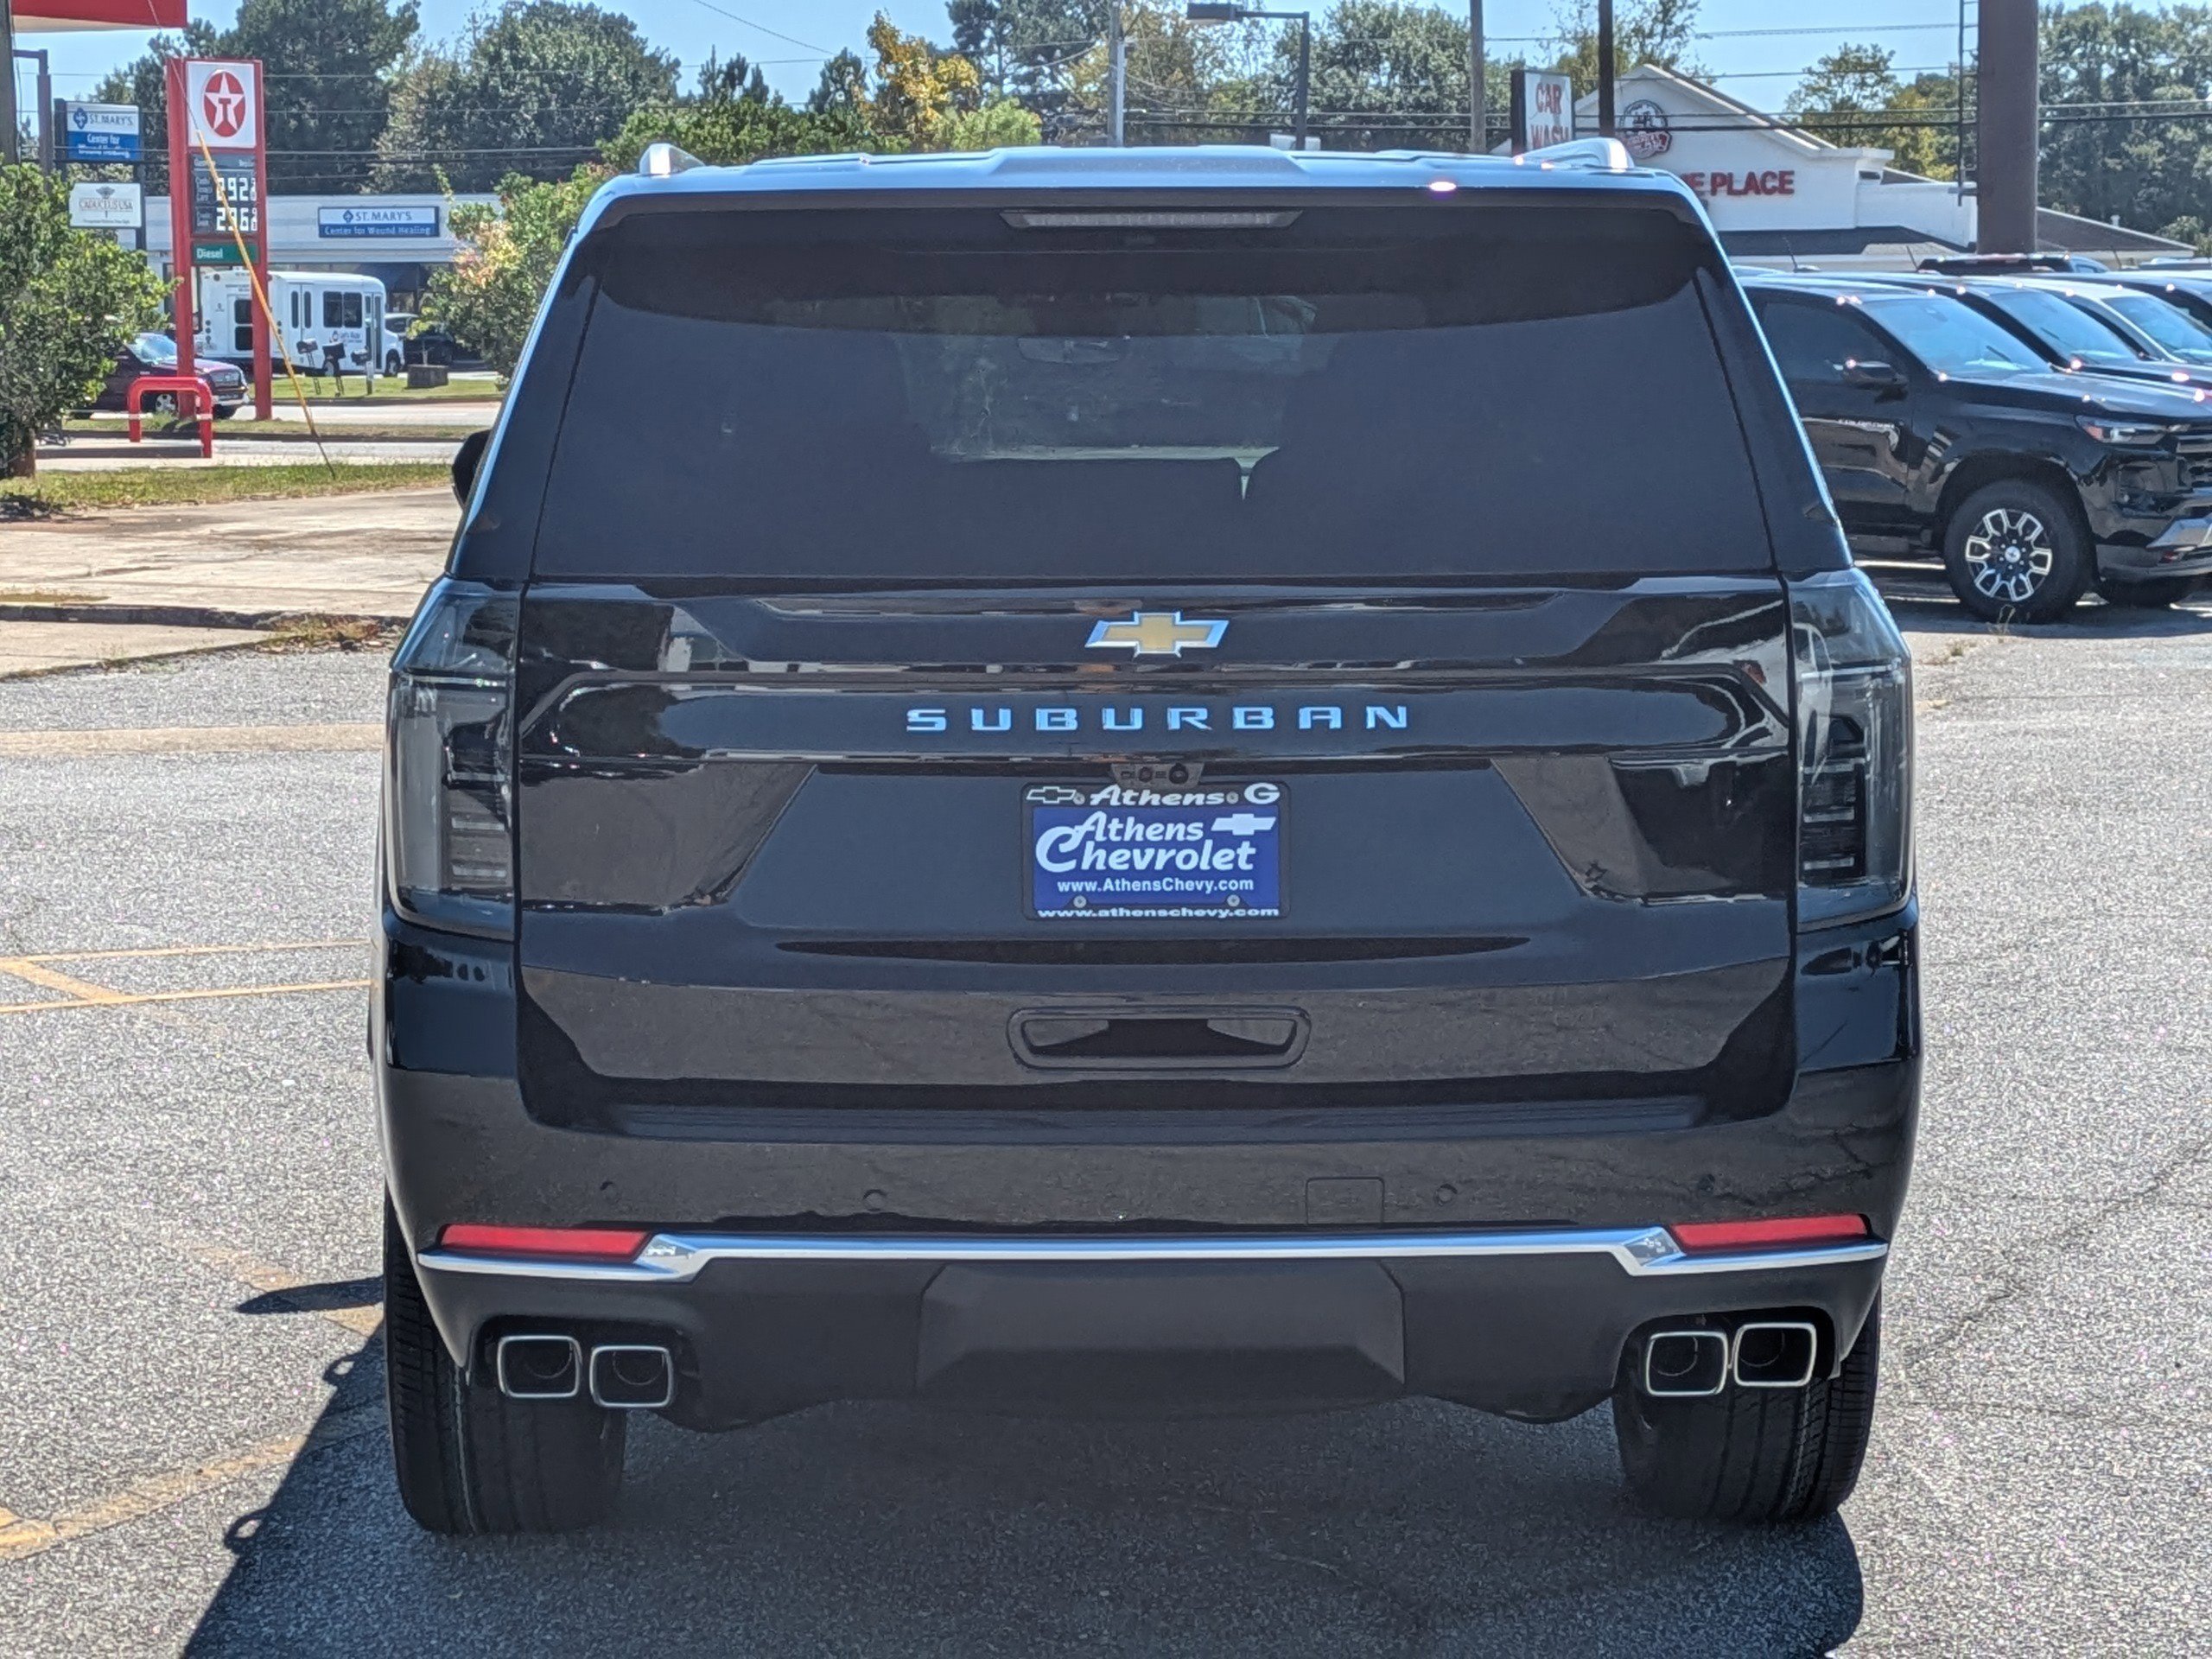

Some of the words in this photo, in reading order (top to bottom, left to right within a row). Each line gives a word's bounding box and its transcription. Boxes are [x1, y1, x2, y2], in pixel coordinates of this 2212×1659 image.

[1535, 83, 1562, 115] CAR
[1530, 124, 1570, 149] WASH
[1710, 170, 1795, 196] PLACE
[372, 211, 412, 221] MARY'S
[324, 226, 352, 235] Center
[353, 226, 365, 235] for
[367, 226, 396, 235] Wound
[398, 226, 431, 236] Healing
[196, 248, 224, 259] Diesel
[906, 707, 1408, 731] SUBURBAN
[1090, 784, 1225, 806] Athens
[1244, 783, 1281, 804] G
[1074, 810, 1205, 842] Athens
[1036, 826, 1257, 873] Chevrolet
[1058, 877, 1254, 894] www.AthensChevy.com
[1038, 907, 1279, 918] www.athenschevy.com
